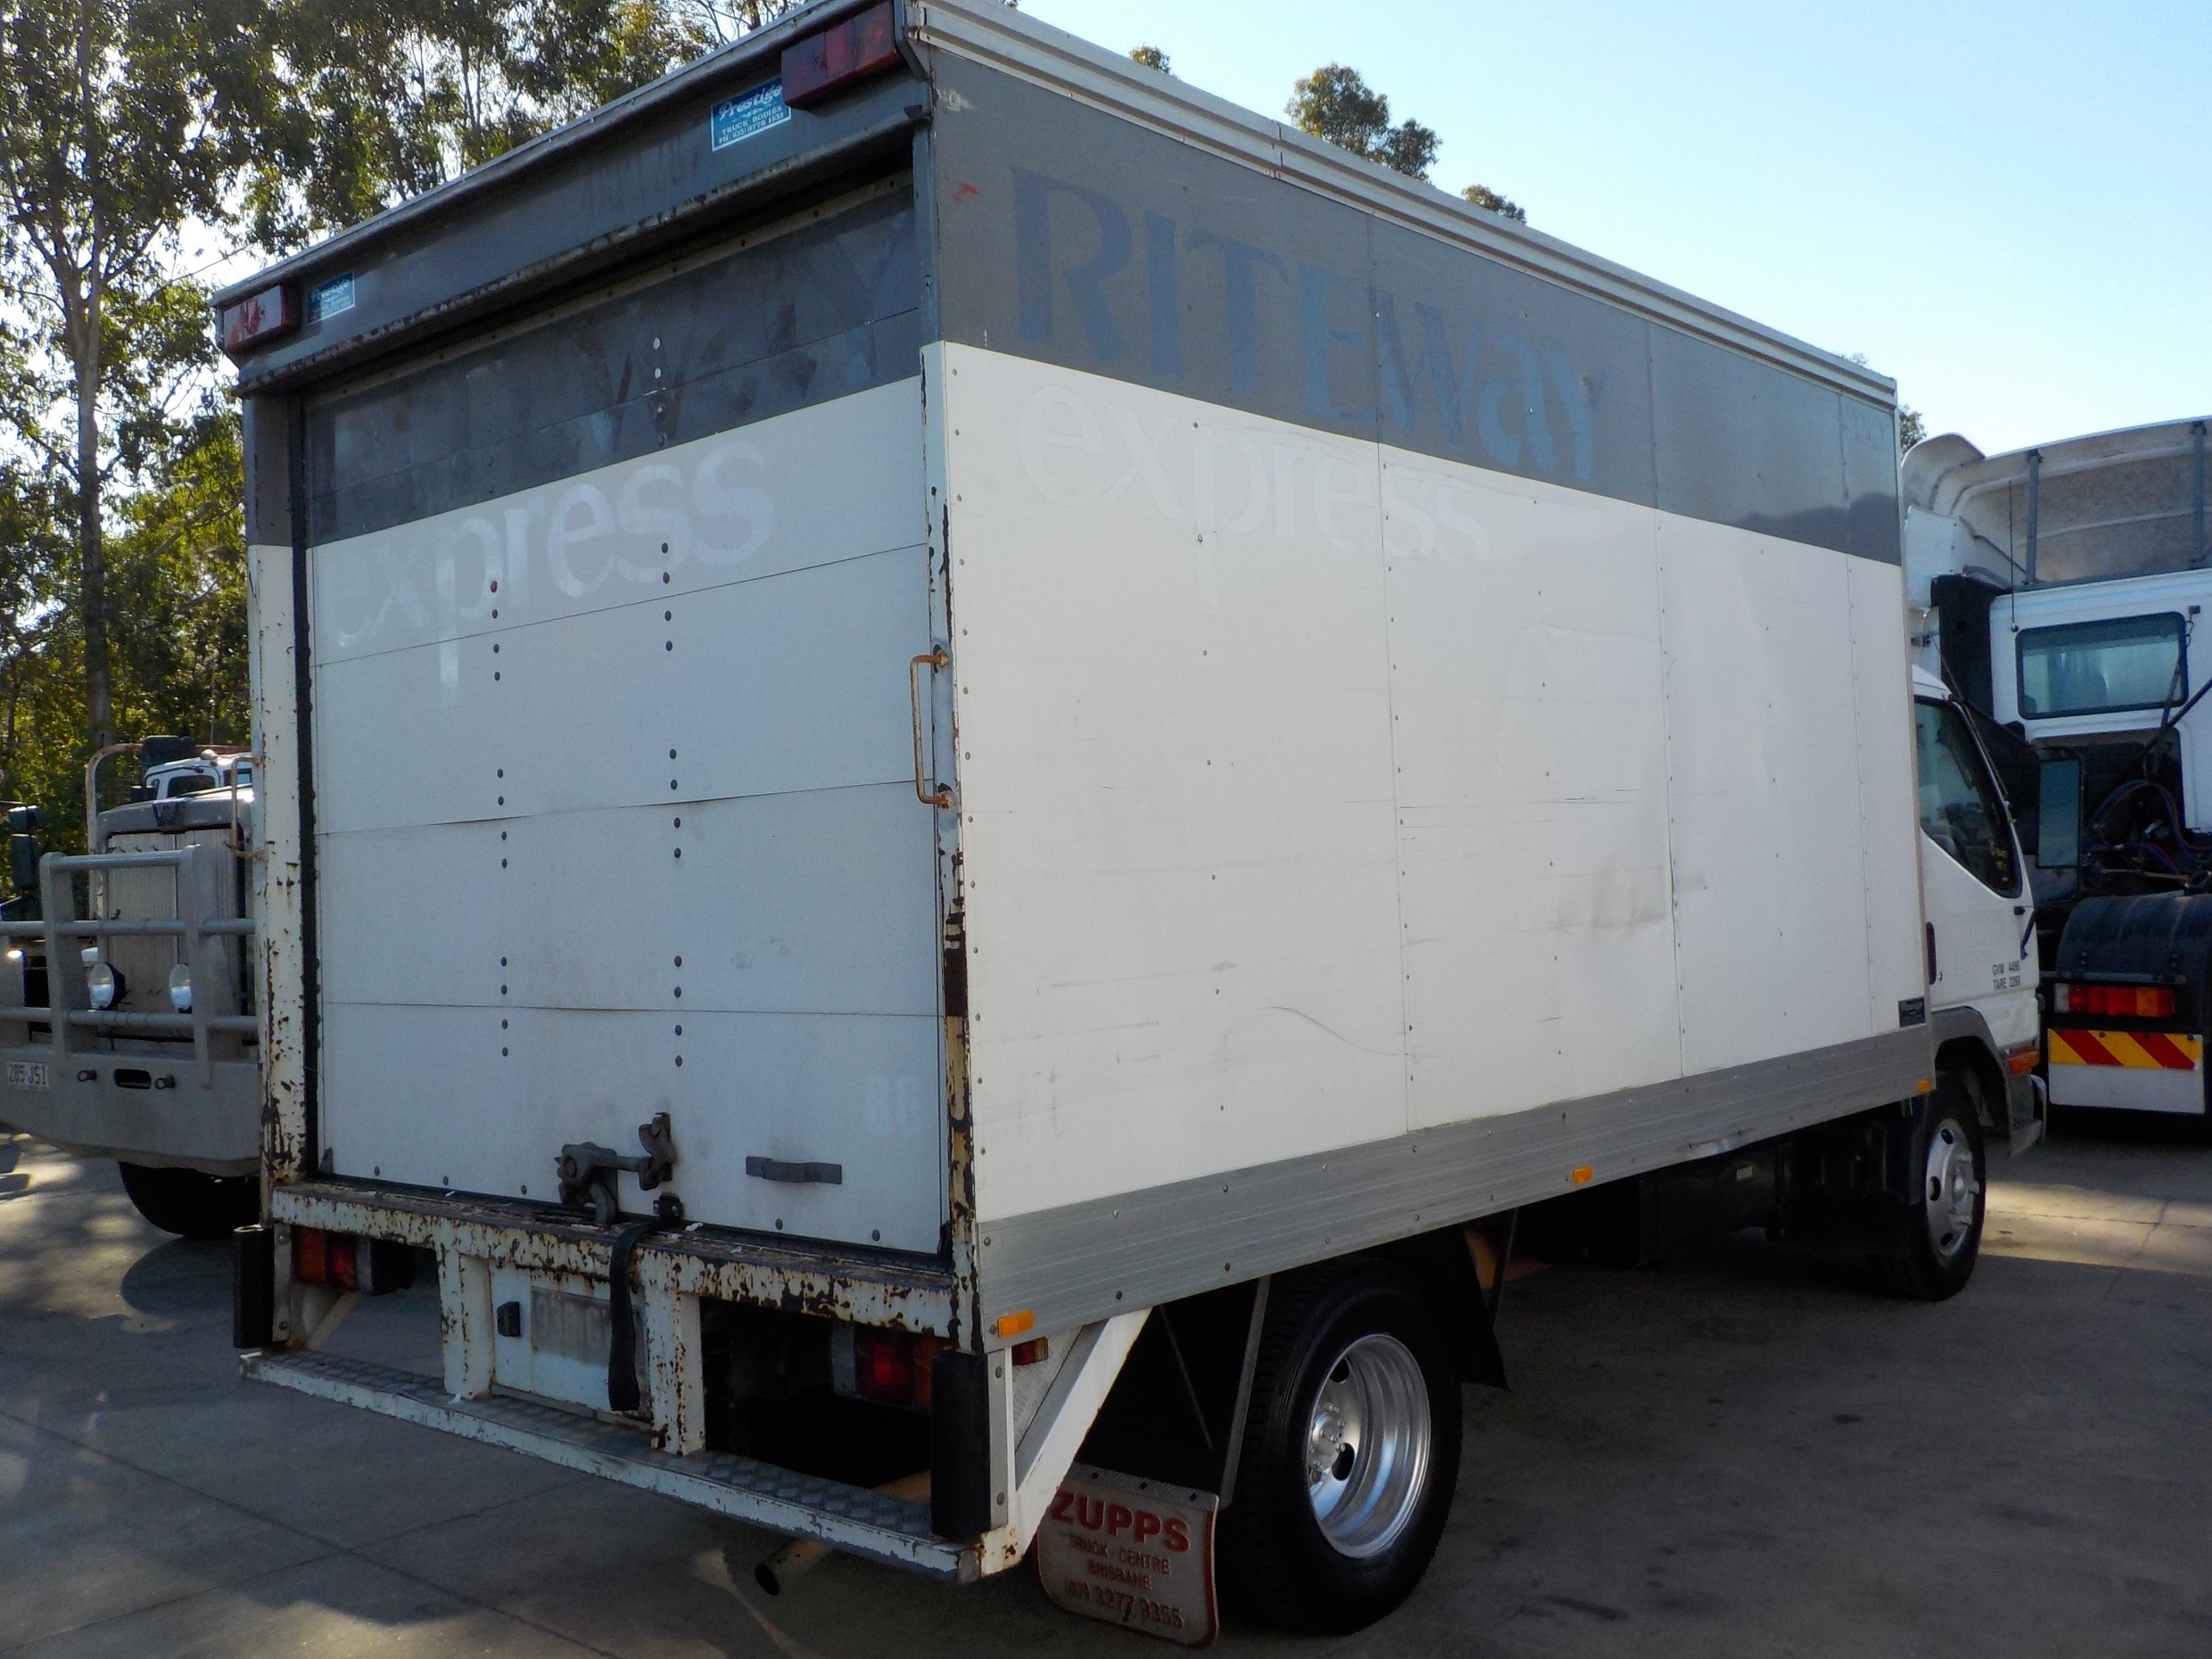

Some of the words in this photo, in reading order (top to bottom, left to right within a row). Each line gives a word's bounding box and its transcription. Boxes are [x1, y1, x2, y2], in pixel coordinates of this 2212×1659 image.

[722, 120, 749, 136] TRUCK
[752, 105, 782, 123] BODIES
[1017, 384, 1490, 615] express
[1050, 1490, 1192, 1554] ZUPPS
[1069, 1533, 1110, 1560] TRUCK
[1120, 1548, 1172, 1576] CENTRE
[1087, 1560, 1153, 1592] BRISBANE
